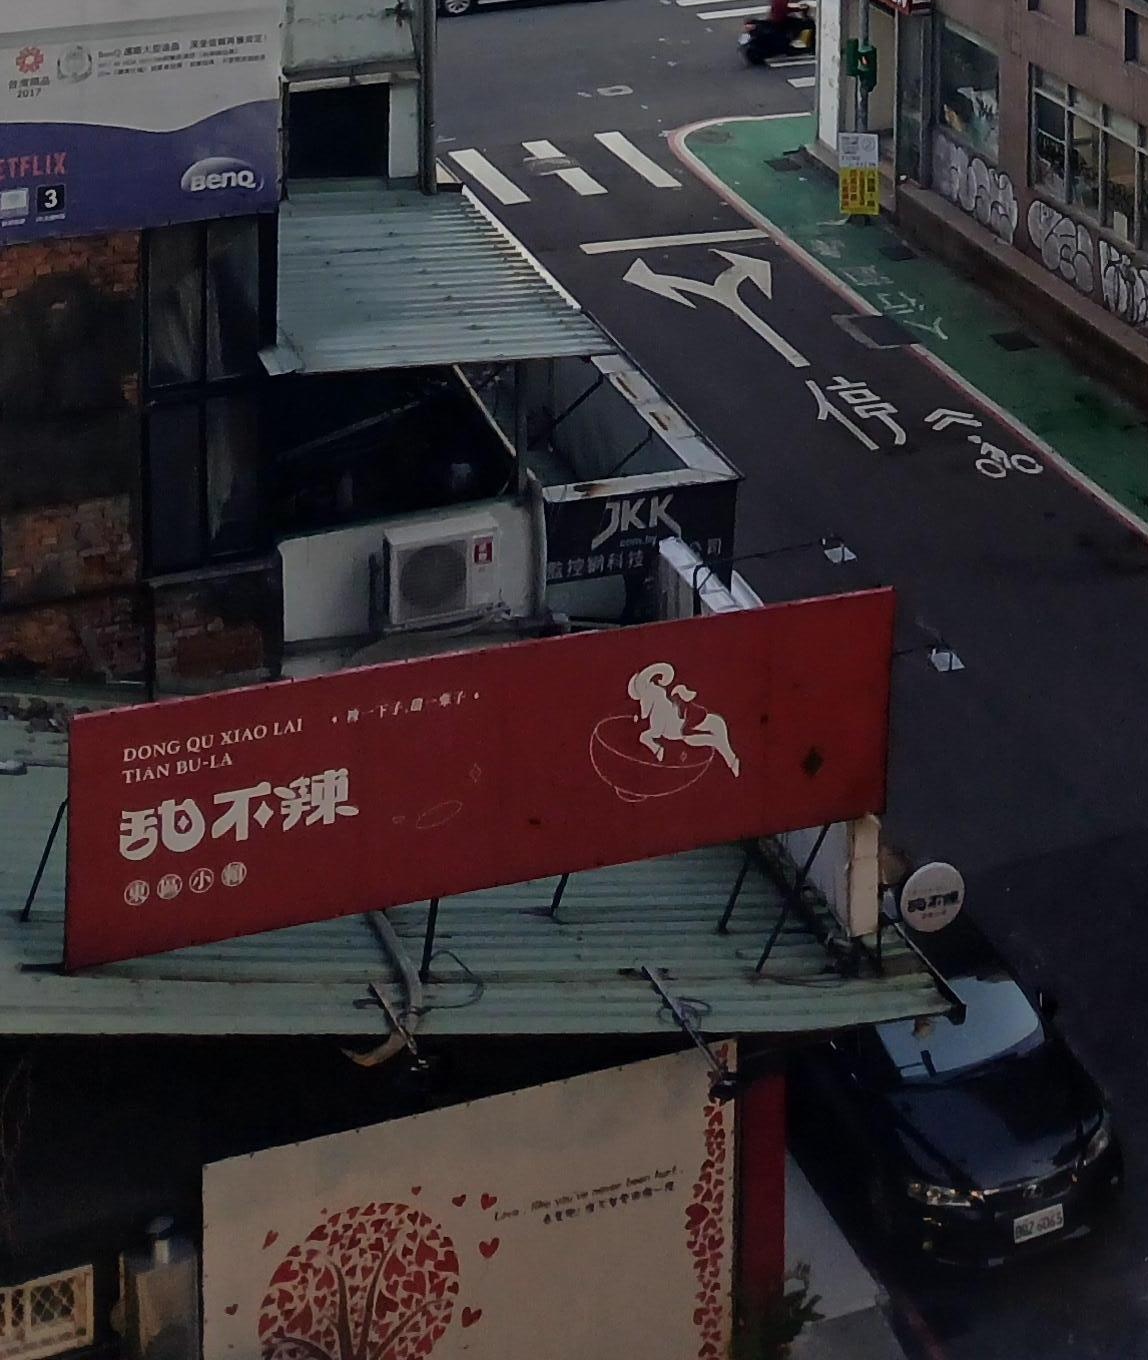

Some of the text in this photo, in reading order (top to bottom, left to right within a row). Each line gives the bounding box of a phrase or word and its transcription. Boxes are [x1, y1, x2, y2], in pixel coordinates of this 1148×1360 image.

[17, 87, 41, 98] 2017
[190, 169, 257, 192] BenQ
[44, 189, 58, 208] 3
[591, 493, 682, 551] JKK
[123, 718, 303, 762] DONG QU XIAO LAI
[121, 752, 233, 784] TIAN BU-LA
[119, 767, 360, 861] 甜不辣
